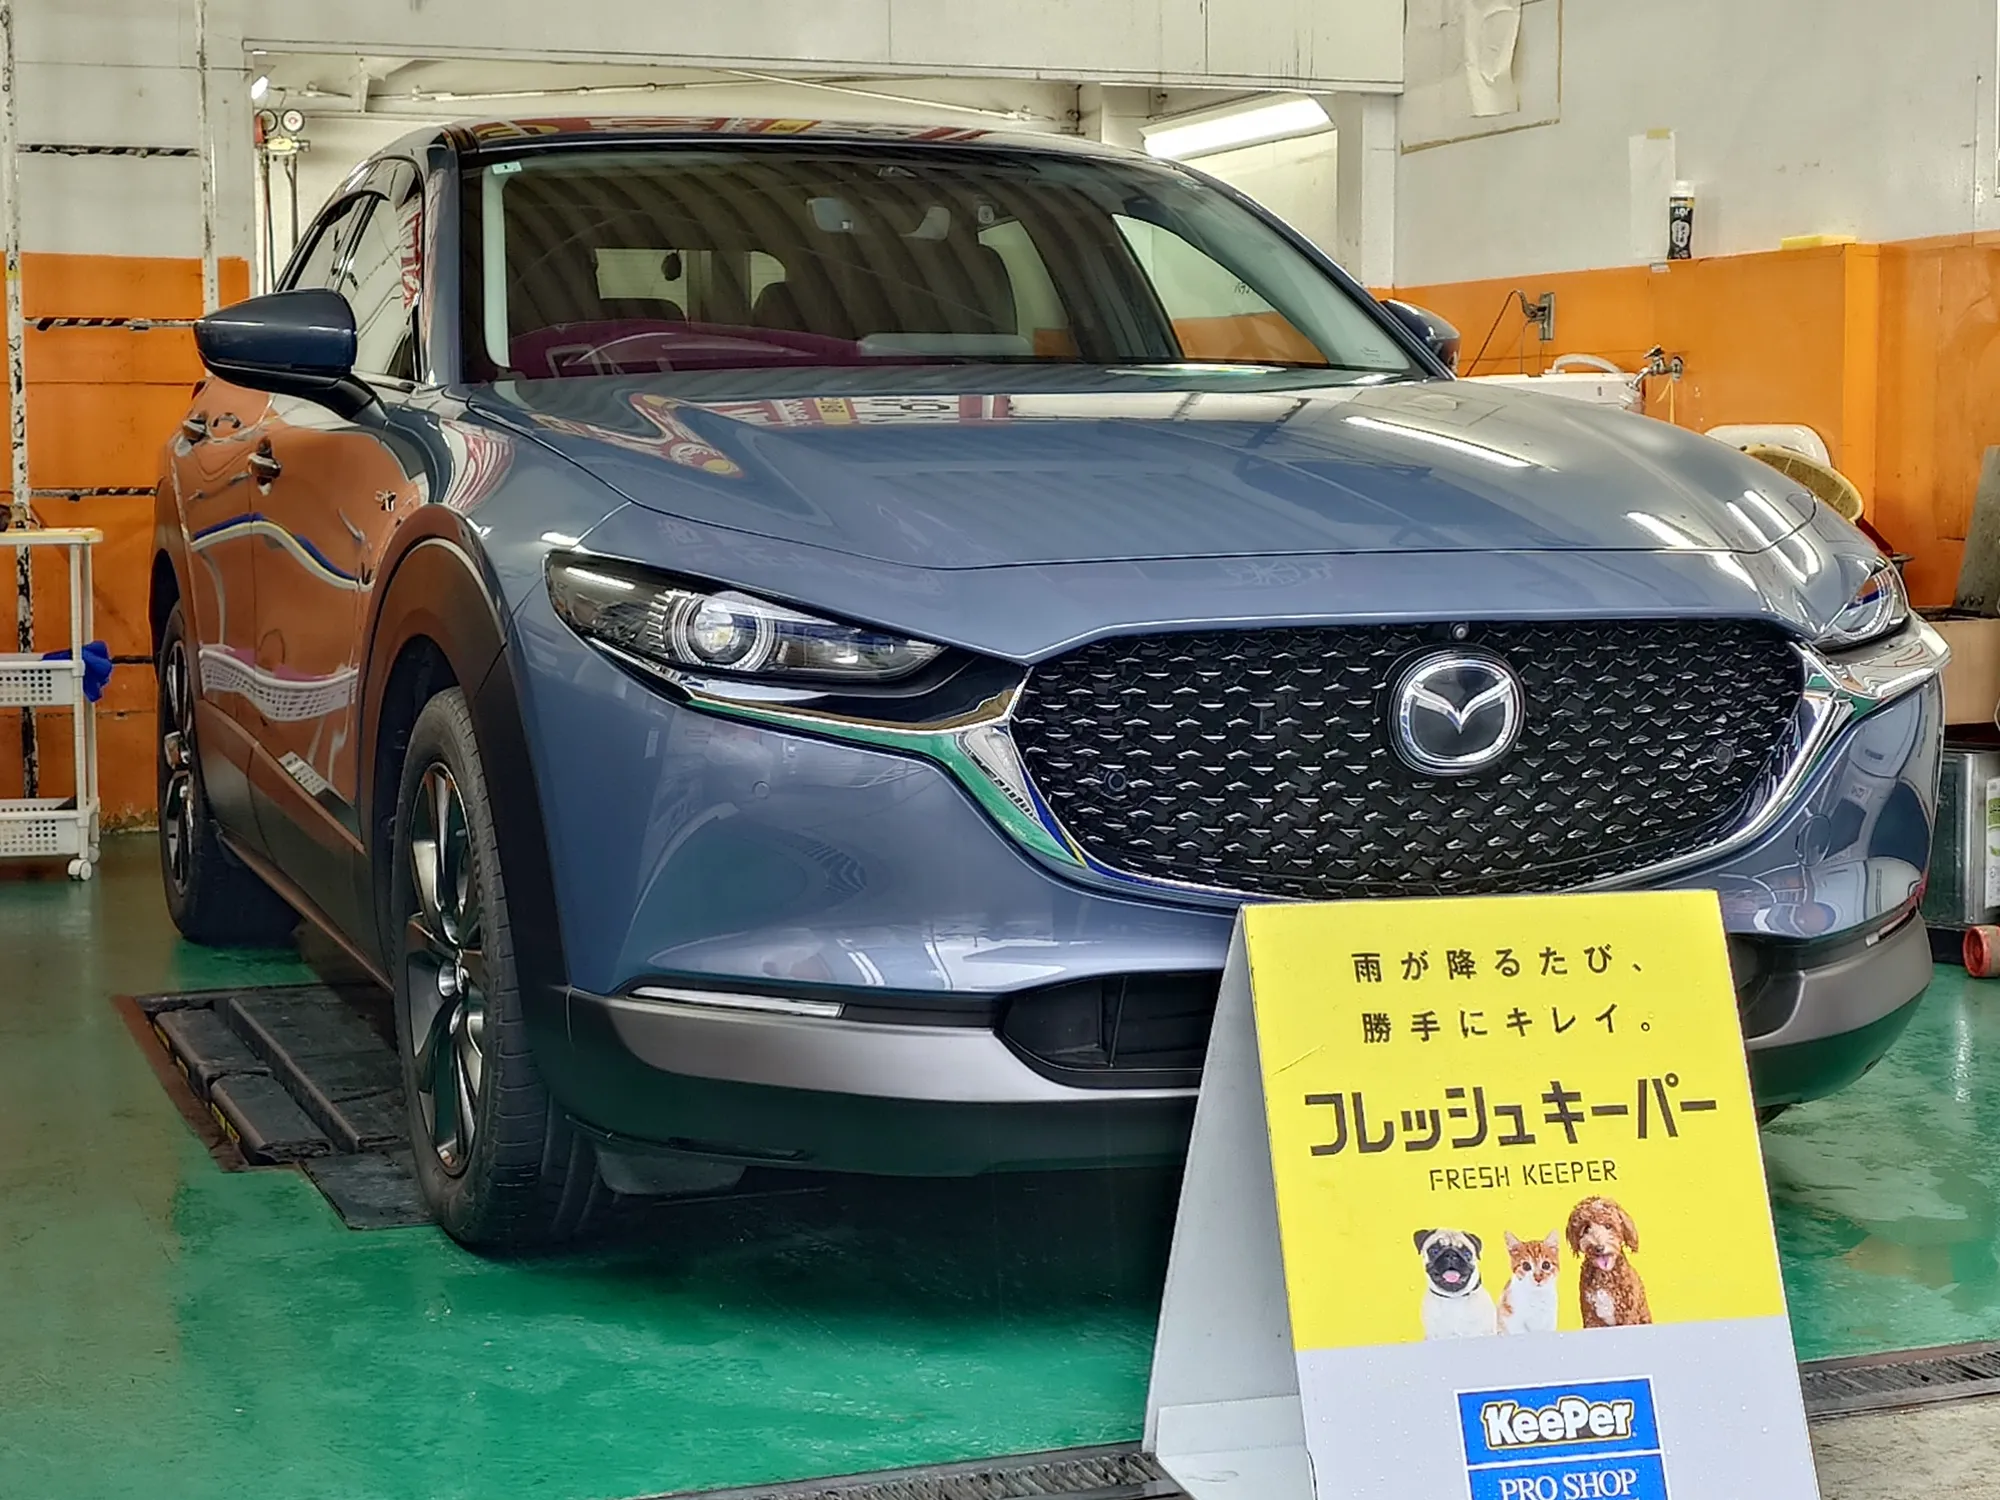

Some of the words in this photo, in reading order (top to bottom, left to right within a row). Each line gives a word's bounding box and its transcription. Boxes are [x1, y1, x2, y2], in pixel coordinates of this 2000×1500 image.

[1351, 944, 1643, 983] 雨が降るたび、
[1361, 1003, 1651, 1044] 勝手にキレイ。
[1304, 1072, 1718, 1157] フレッシュキーパー
[1429, 1165, 1510, 1191] FRESH
[1523, 1159, 1618, 1186] KEEPER
[1483, 1396, 1633, 1447] KeePer
[1498, 1475, 1558, 1500] PRO
[1563, 1468, 1638, 1500] SHOP
